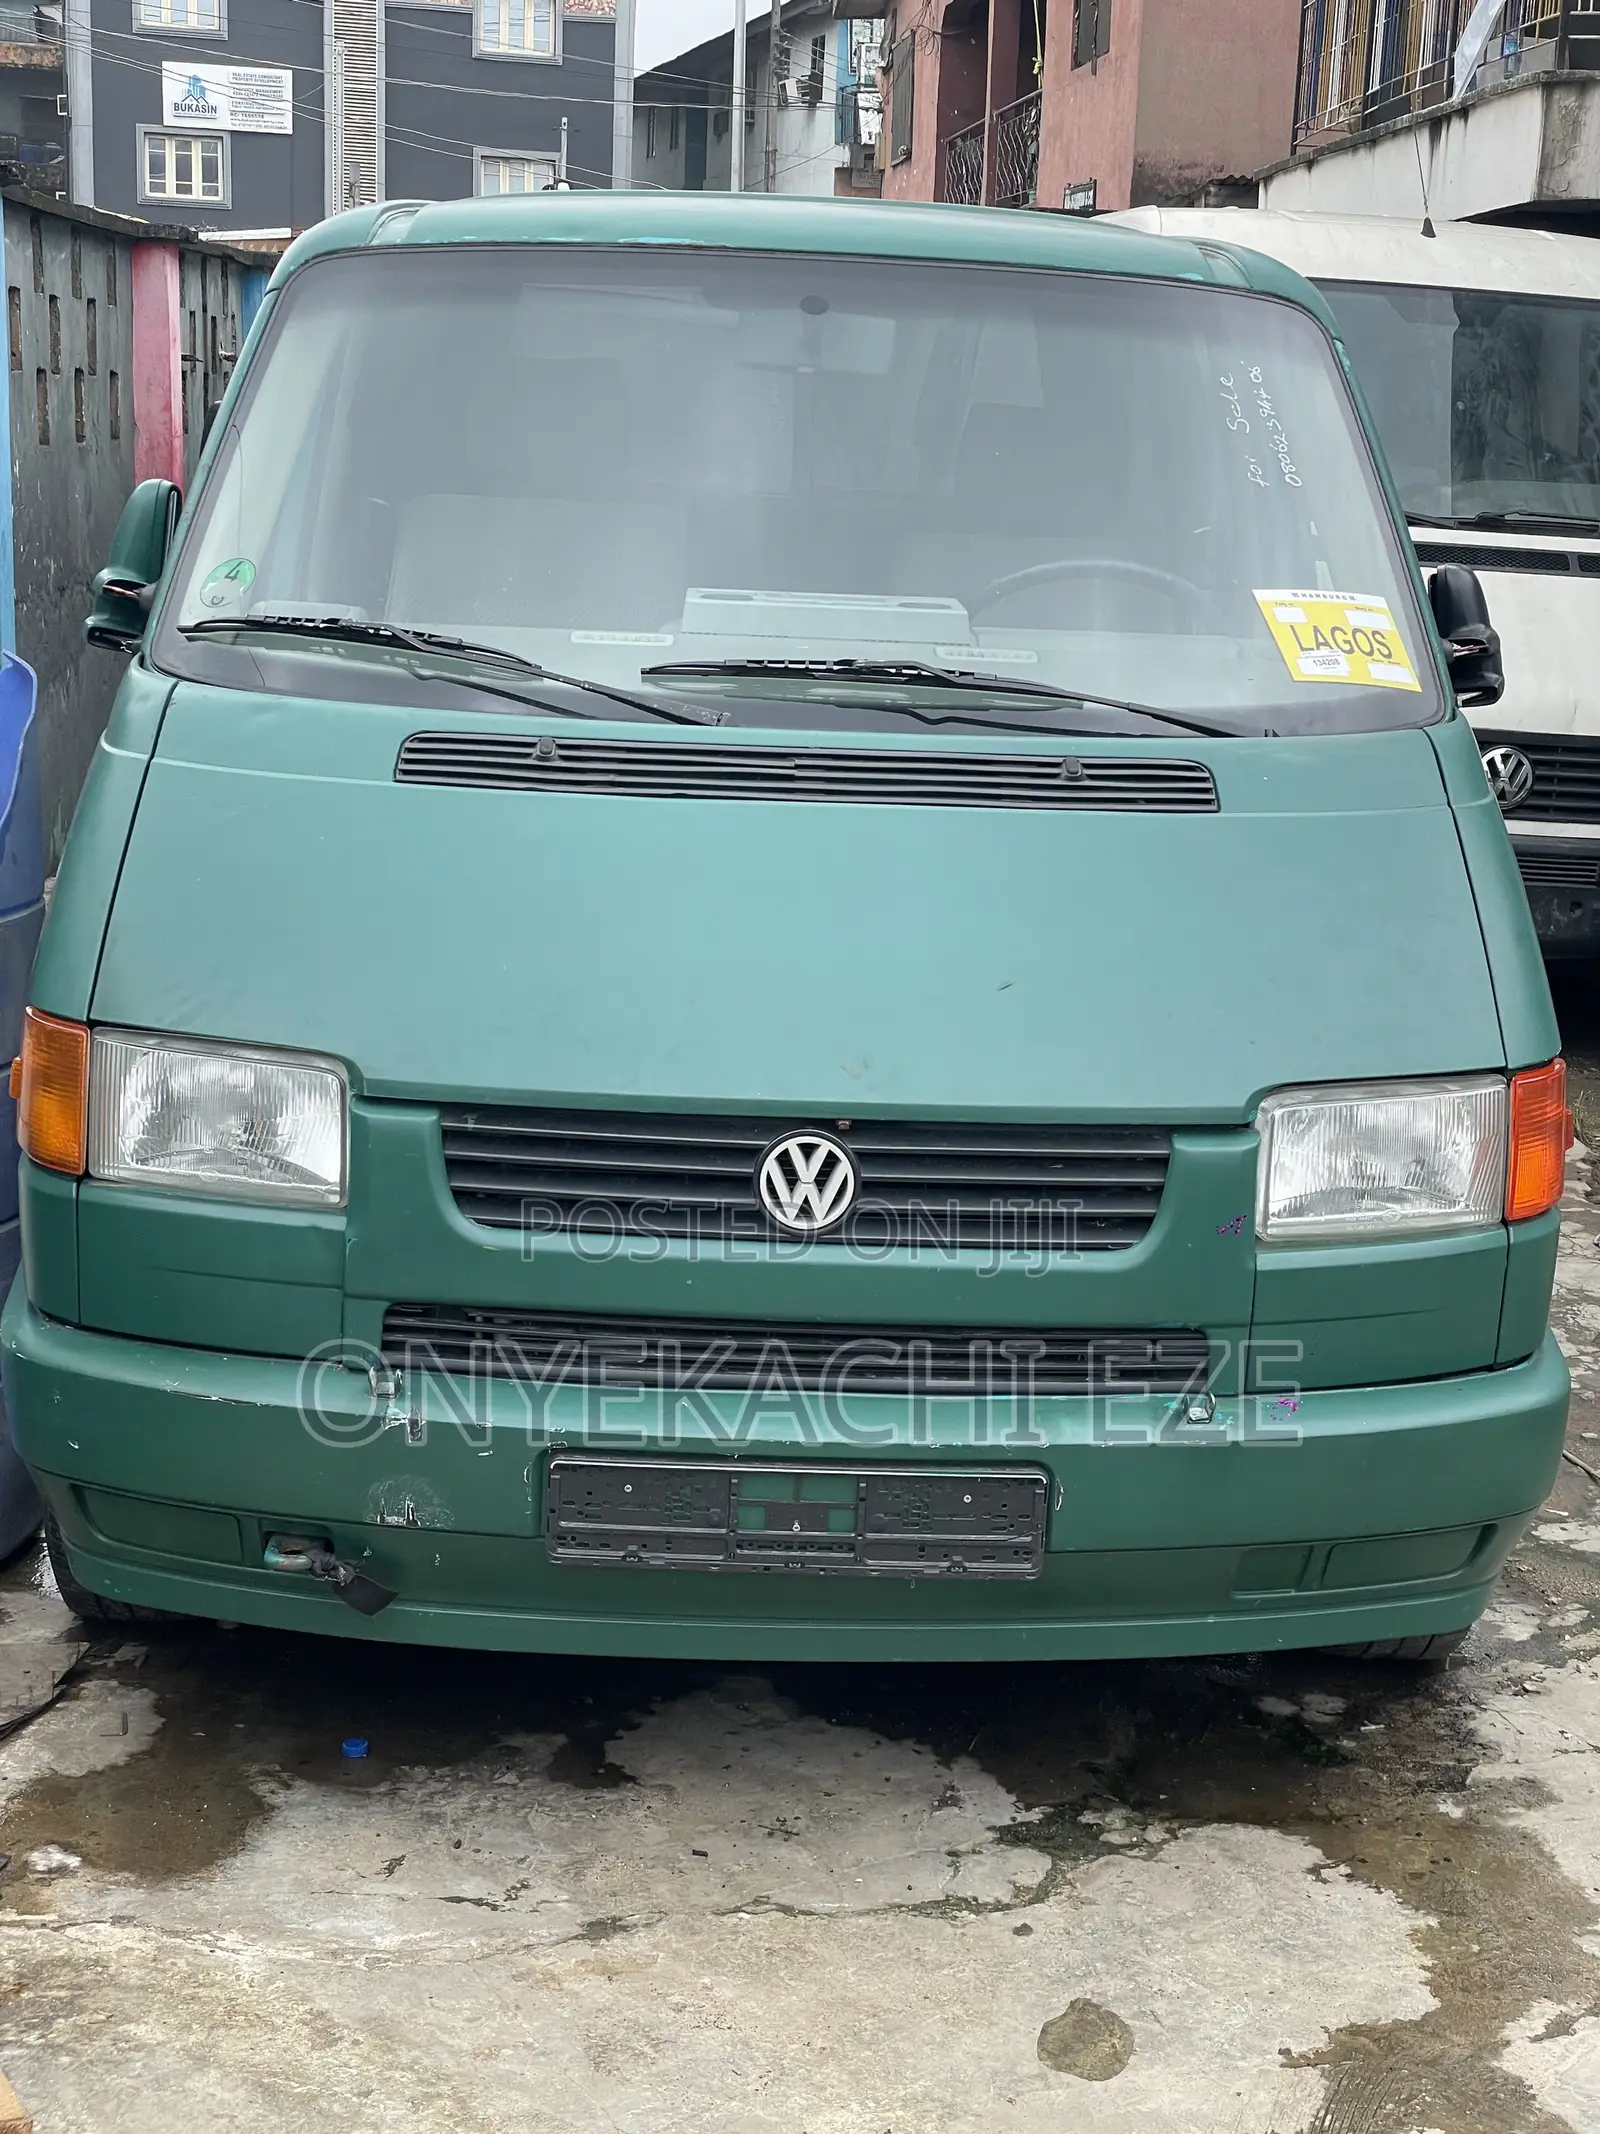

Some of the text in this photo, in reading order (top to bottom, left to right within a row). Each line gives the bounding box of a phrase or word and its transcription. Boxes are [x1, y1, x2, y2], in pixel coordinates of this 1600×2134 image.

[173, 102, 217, 115] BUKASIN
[1301, 592, 1349, 601] HAMBURG
[1289, 624, 1393, 660] LAGOS
